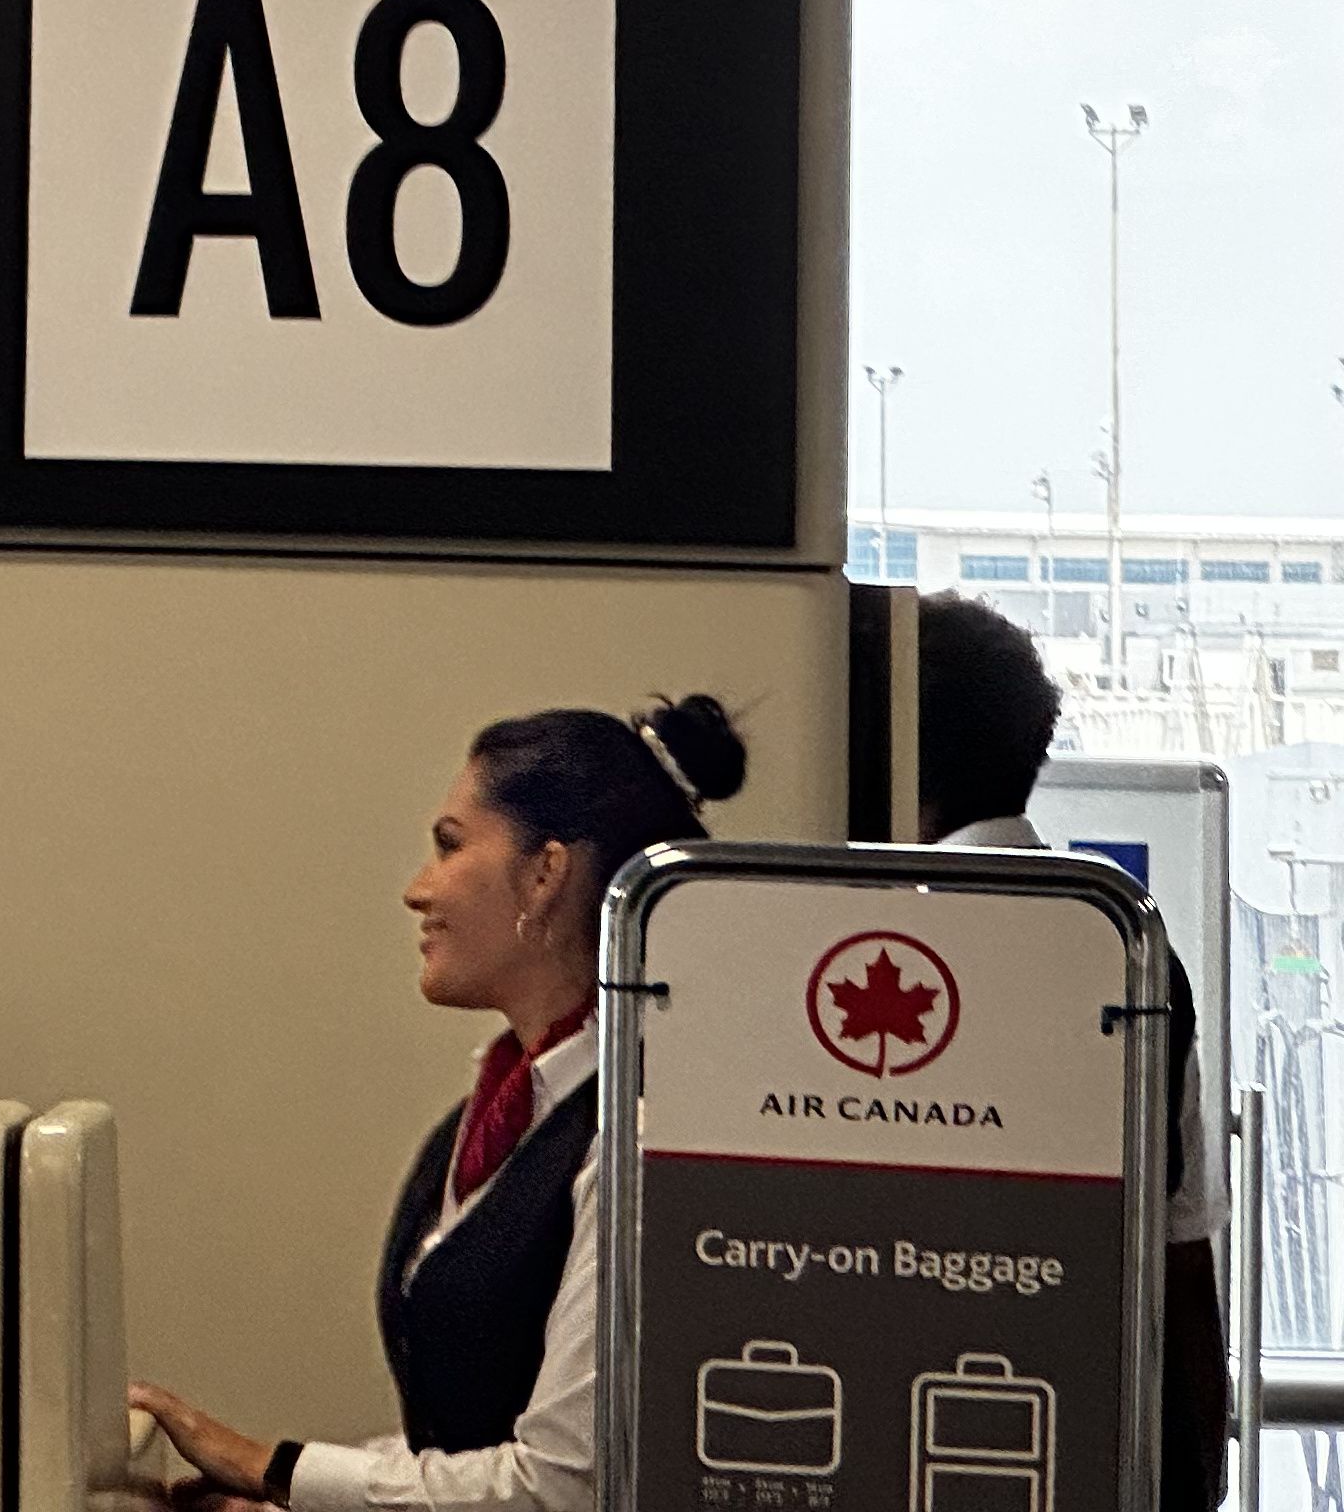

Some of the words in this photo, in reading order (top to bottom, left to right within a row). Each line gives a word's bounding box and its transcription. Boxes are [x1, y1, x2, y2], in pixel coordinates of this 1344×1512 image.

[759, 1092, 827, 1119] AIR
[837, 1097, 1004, 1129] CANADA
[694, 1228, 880, 1282] Carry-on
[893, 1240, 1065, 1296] Baggage
